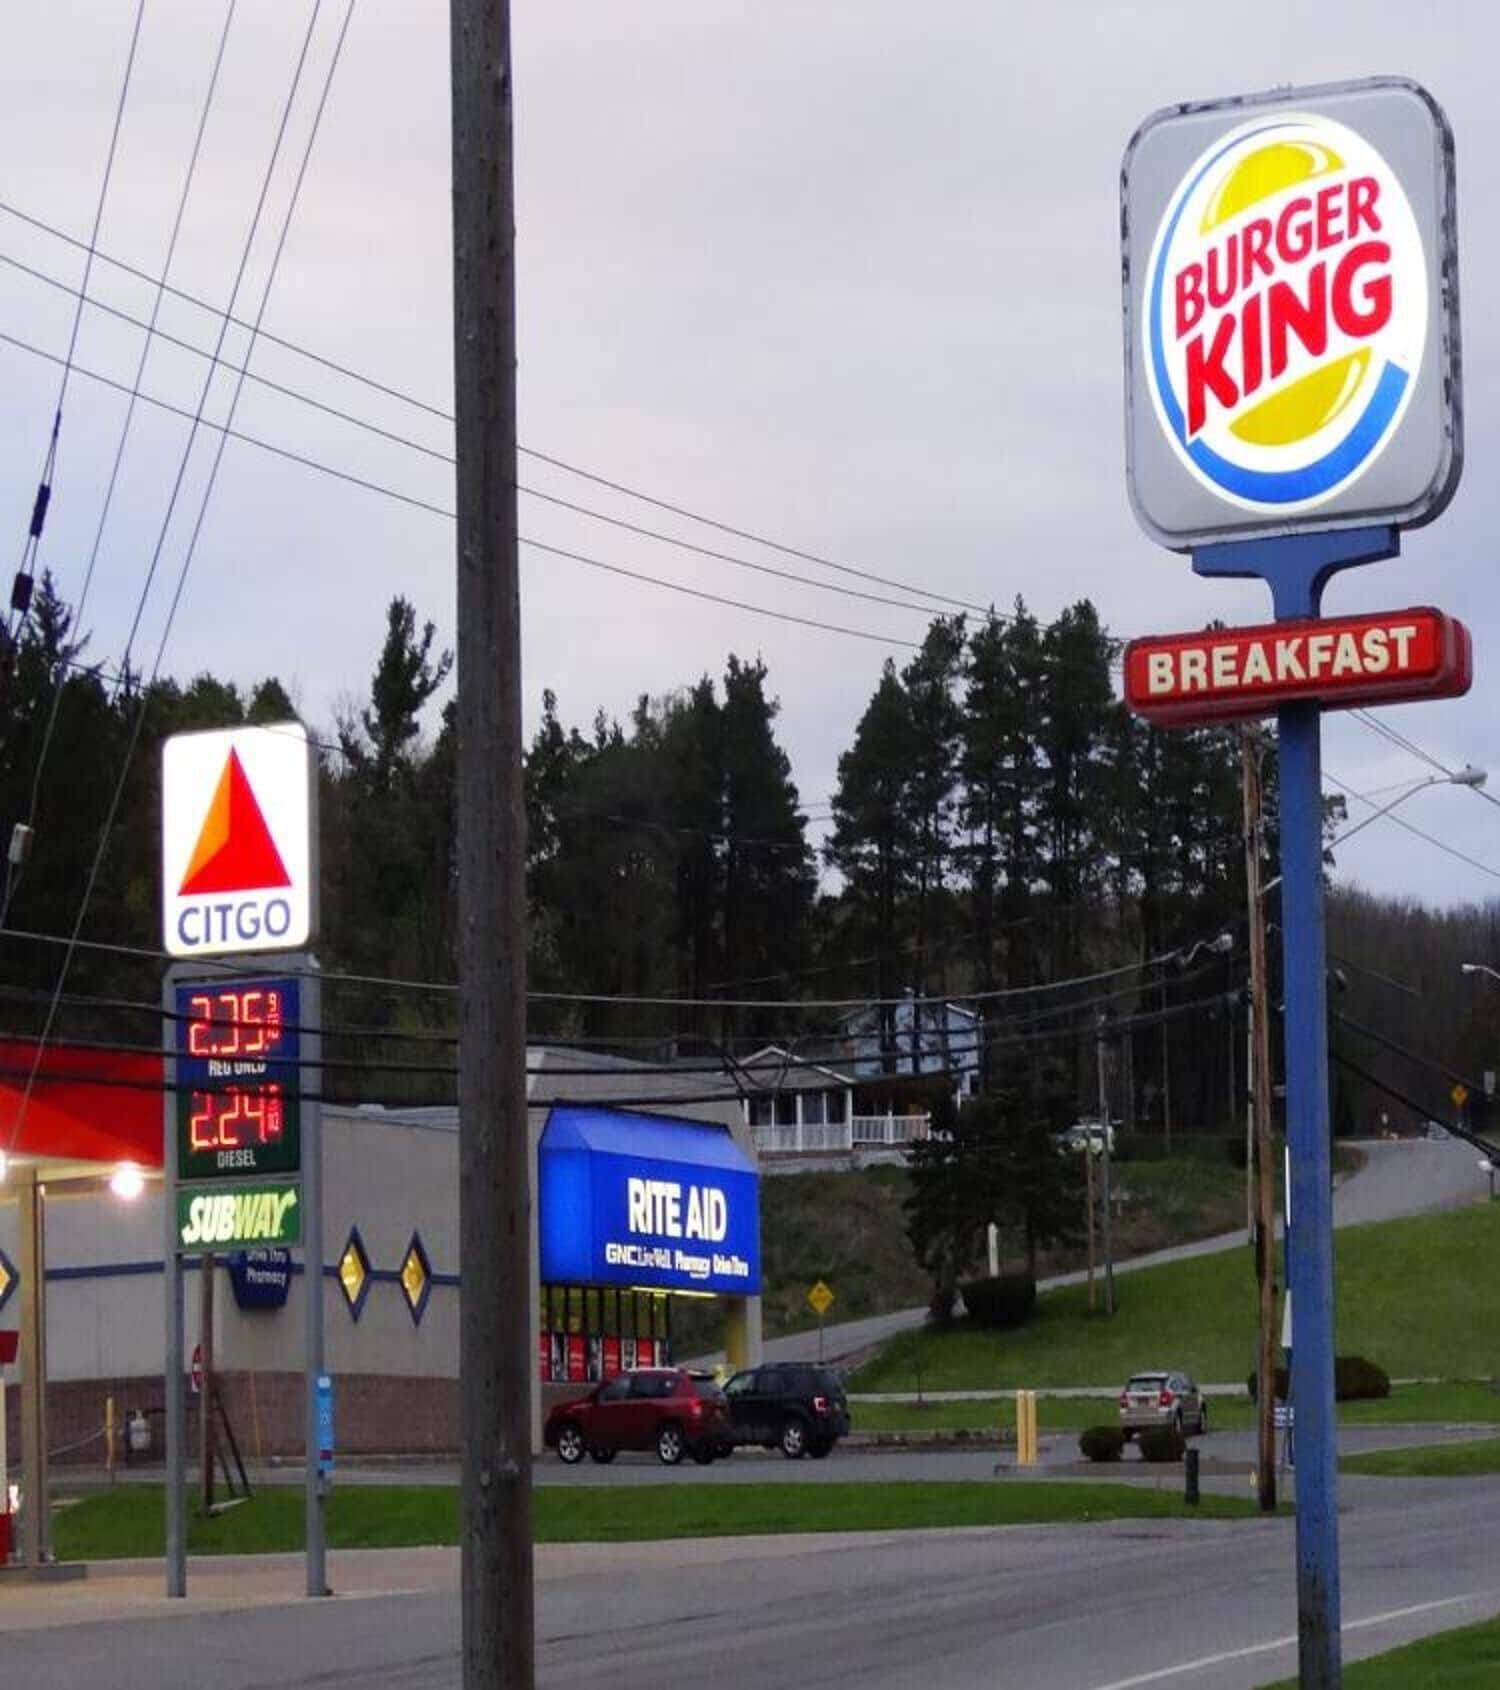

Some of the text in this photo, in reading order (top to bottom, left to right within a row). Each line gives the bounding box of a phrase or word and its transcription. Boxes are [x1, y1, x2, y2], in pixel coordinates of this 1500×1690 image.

[1175, 176, 1382, 341] BURGER
[1186, 240, 1392, 437] KING
[1149, 626, 1416, 694] BREAKFAST
[178, 899, 290, 945] CITGO
[217, 1149, 257, 1168] DIESEL
[181, 1188, 297, 1244] SUBWAY
[627, 1177, 727, 1242] RITE AID
